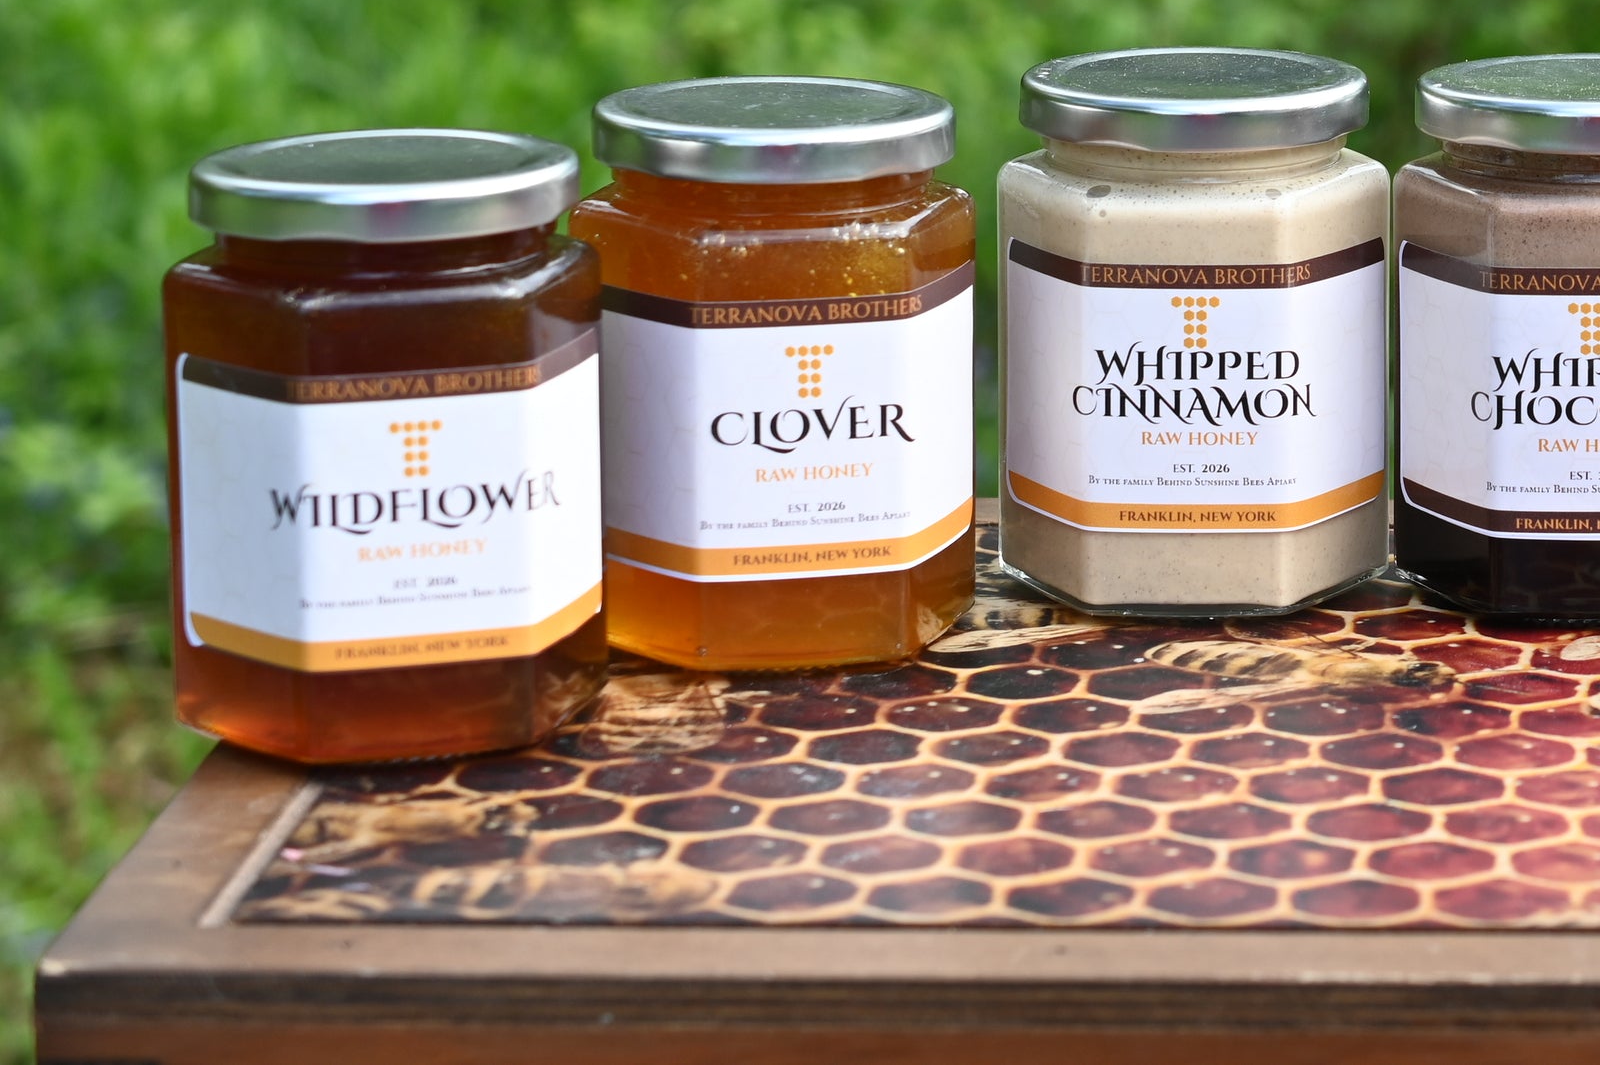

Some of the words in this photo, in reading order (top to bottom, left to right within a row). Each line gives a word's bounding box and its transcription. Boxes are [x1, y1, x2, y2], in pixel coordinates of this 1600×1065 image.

[1082, 265, 1209, 285] TERRANOVA
[1214, 263, 1312, 285] BROTHERS
[689, 303, 823, 326] TERRANOVA
[828, 294, 923, 321] BROTHERS
[1095, 341, 1300, 386] WHIPPED
[1072, 383, 1318, 426] CINNAMON
[710, 395, 916, 454] CLOVER
[1141, 431, 1183, 446] RAW
[1188, 431, 1259, 446] HONEY
[1537, 438, 1580, 453] RAW
[755, 466, 799, 484] RAW
[803, 462, 874, 481] HONEY
[1172, 463, 1196, 474] EST.
[1201, 463, 1230, 474] 2026
[1569, 470, 1593, 481] EST.
[1499, 484, 1518, 493] THE
[1519, 485, 1551, 494] FAMILY
[1553, 483, 1589, 494] BEHIND
[270, 469, 561, 535] WILDFLOWER
[816, 501, 846, 513] 2026
[1119, 510, 1196, 524] FRANKLIN,
[1200, 511, 1233, 523] NEW
[1236, 511, 1277, 523] YORK
[1515, 517, 1593, 531] FRANKLIN,
[357, 544, 403, 562] RAW
[409, 538, 487, 559] HONEY
[733, 551, 813, 567] FRANKLIN,
[816, 548, 849, 562] NEW
[852, 546, 892, 560] YORK
